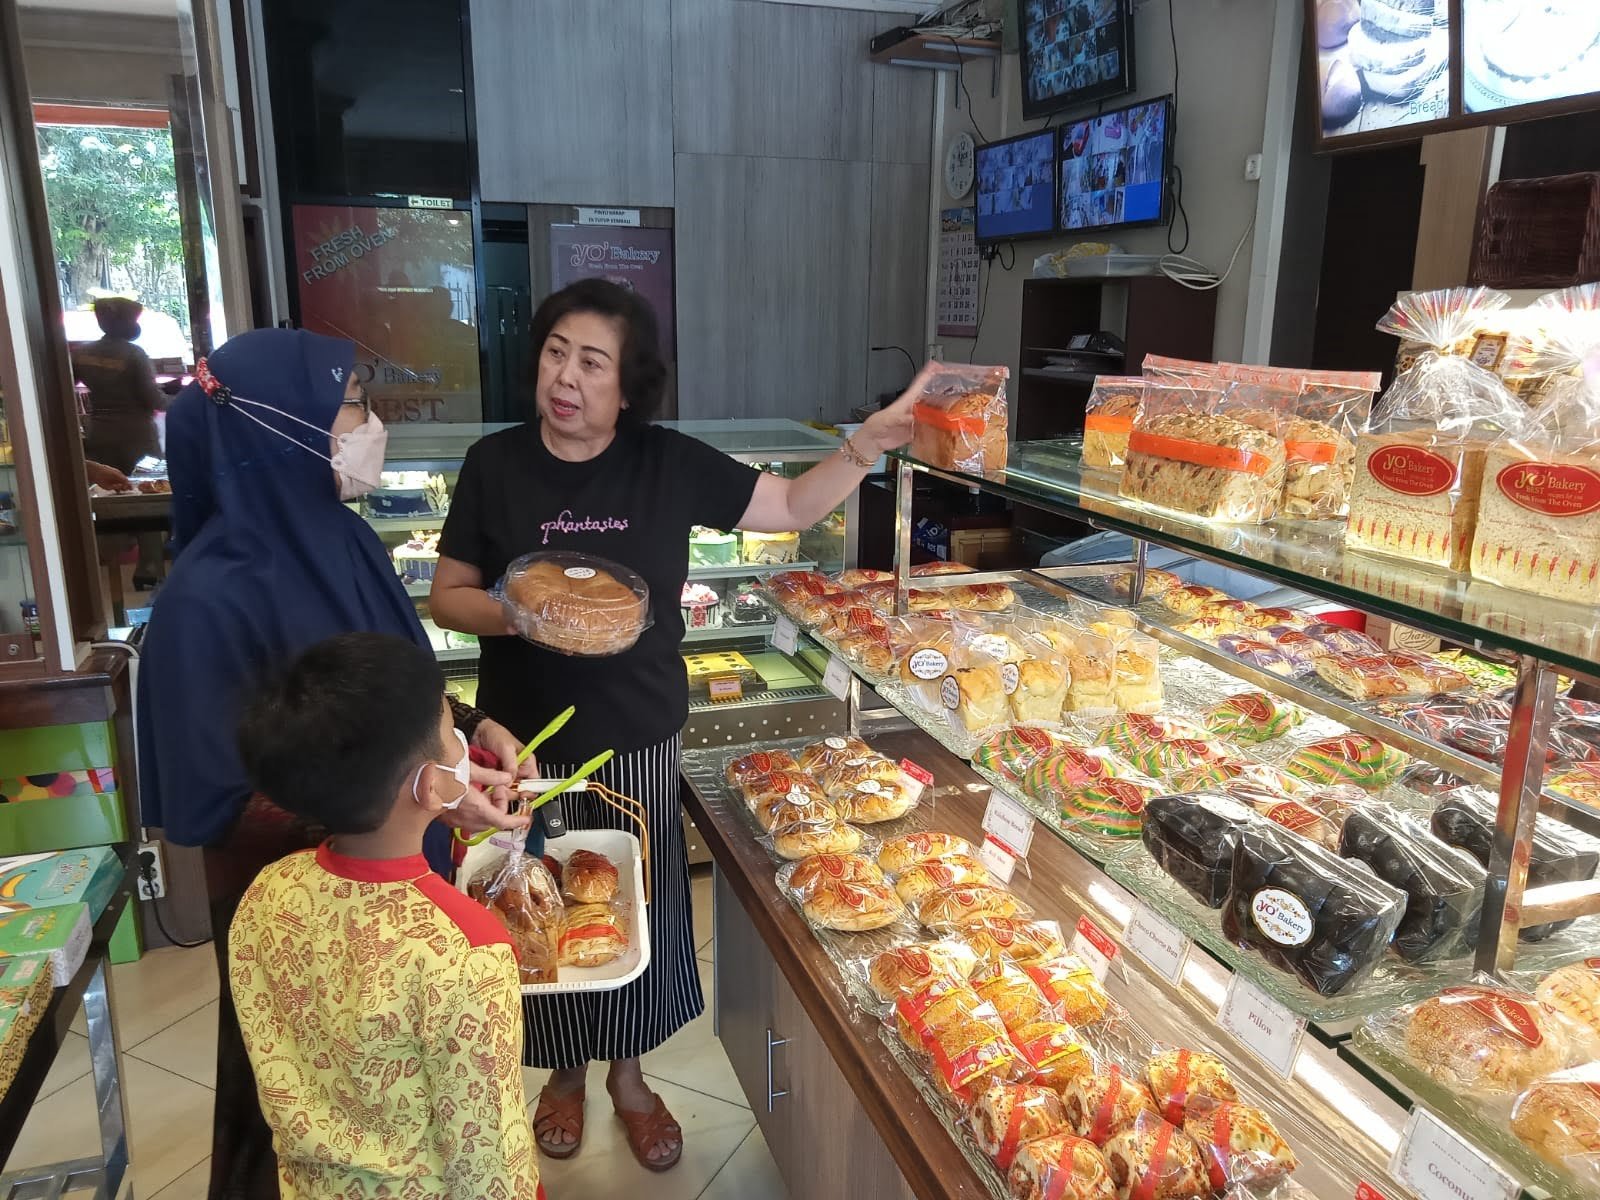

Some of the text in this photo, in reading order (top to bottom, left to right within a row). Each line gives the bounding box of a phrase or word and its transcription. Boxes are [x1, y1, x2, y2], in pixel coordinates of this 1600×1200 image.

[1410, 98, 1444, 115] Bread
[420, 198, 453, 208] TOILET
[309, 225, 364, 262] FRESH
[302, 228, 397, 286] FROM OVEN
[610, 246, 661, 264] Bakery
[1392, 468, 1407, 476] BEST
[1408, 460, 1436, 476] Bakery
[1526, 486, 1545, 495] BEST
[1547, 477, 1586, 493] Bakery
[1515, 492, 1582, 508] Fresh From The Oven
[540, 509, 630, 545] phantasies
[1277, 912, 1306, 935] Bakery
[1496, 1001, 1529, 1027] Bakery
[1247, 1011, 1272, 1036] Pillow
